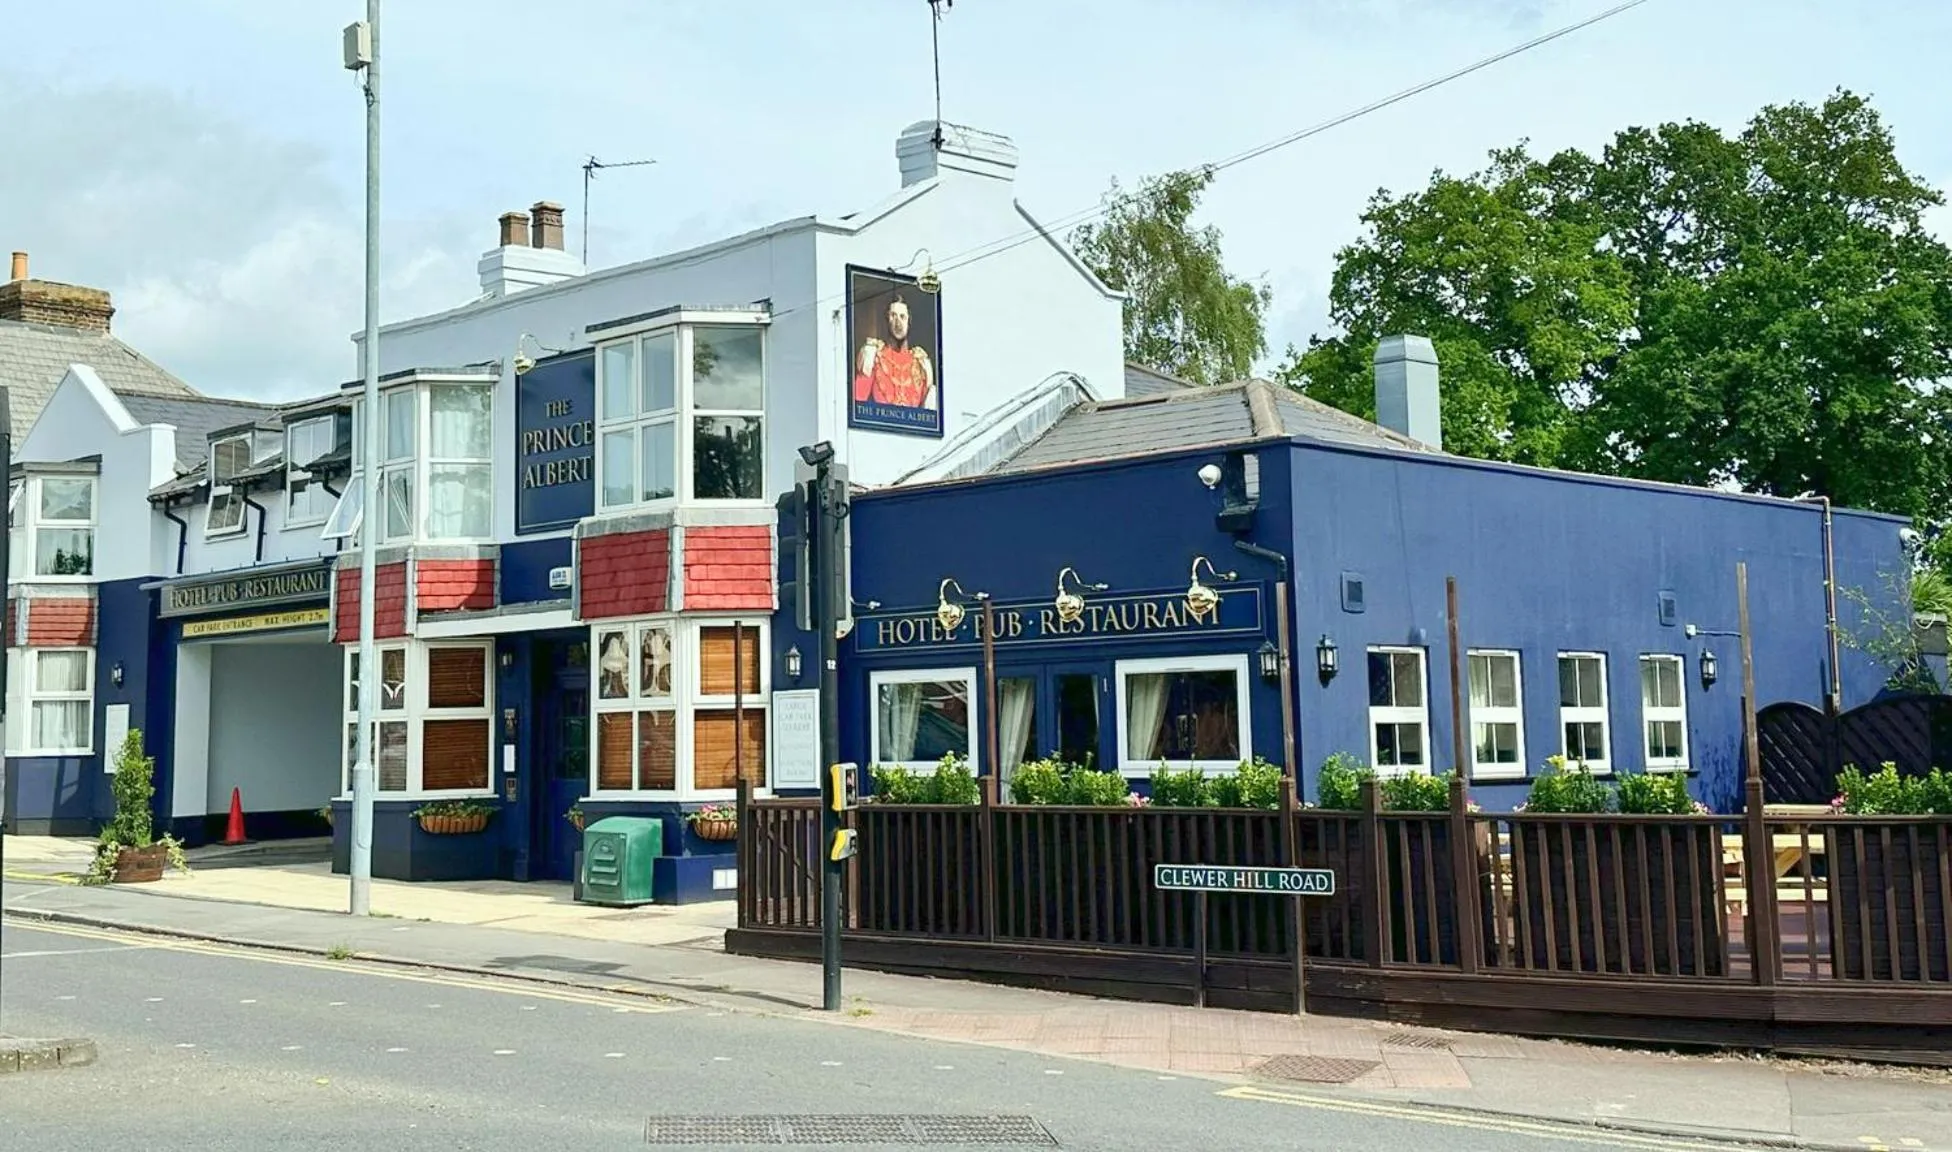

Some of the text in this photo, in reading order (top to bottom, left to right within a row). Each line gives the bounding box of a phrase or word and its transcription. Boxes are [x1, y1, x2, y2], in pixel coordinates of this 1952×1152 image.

[543, 399, 573, 418] THE
[857, 405, 936, 422] THE PRINCE ALBERT
[523, 420, 594, 456] PRINCE
[523, 455, 591, 489] ALBERT
[169, 570, 327, 609] HOTEL PUB RESTAURANT
[264, 616, 279, 625] MAX
[1160, 869, 1329, 891] CLEWER HILL ROAD
